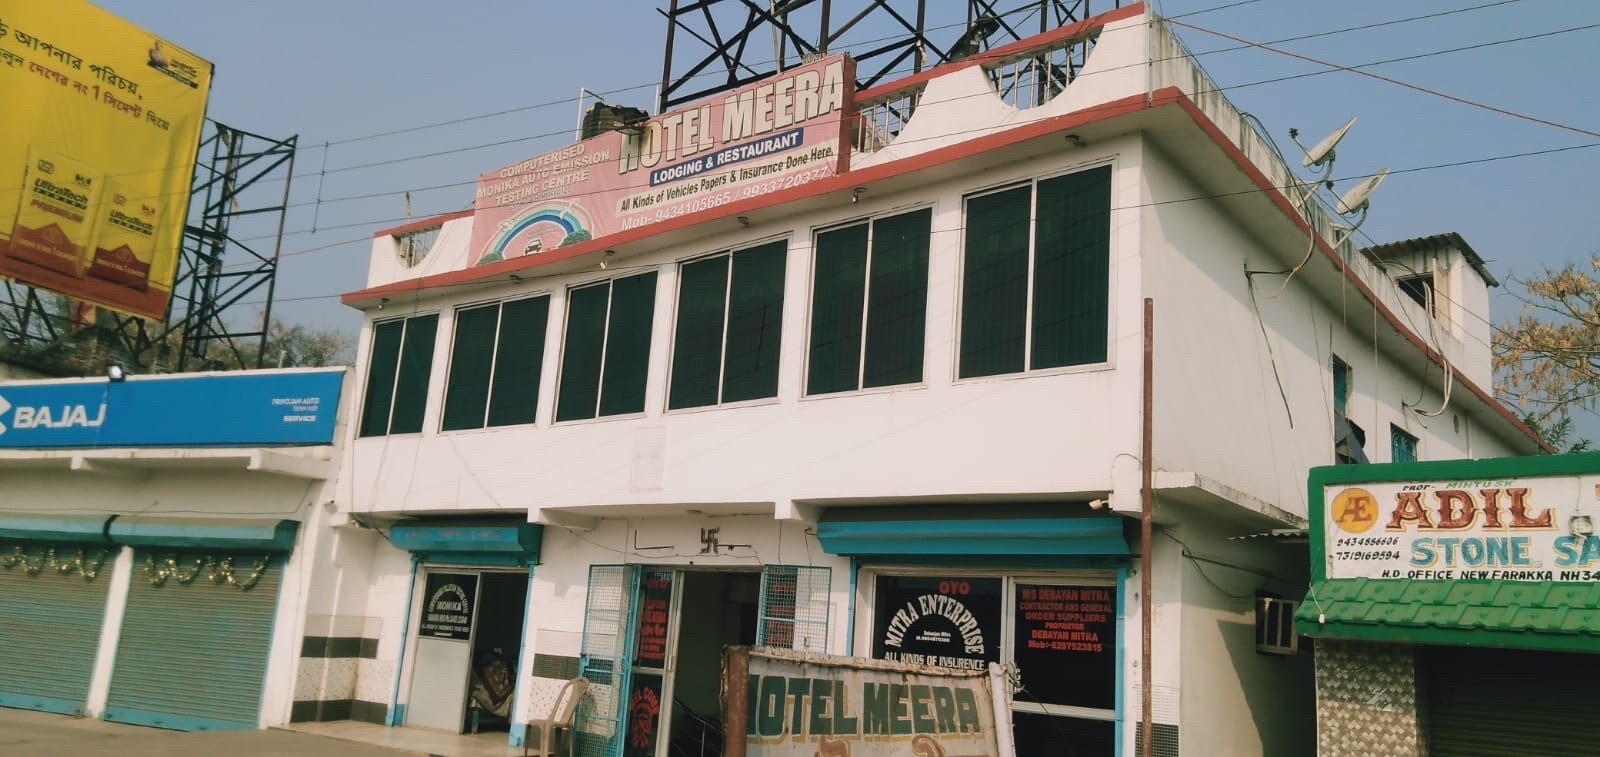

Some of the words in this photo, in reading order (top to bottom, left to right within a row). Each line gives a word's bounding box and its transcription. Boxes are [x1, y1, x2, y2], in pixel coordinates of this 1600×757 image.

[14, 29, 84, 70] আপনার
[29, 61, 70, 86] দেশের
[92, 85, 100, 101] 1
[618, 104, 714, 175] HOTEL
[721, 61, 844, 144] MEERA
[476, 177, 519, 198] MONIKA
[520, 169, 550, 185] AUTO
[553, 149, 610, 175] EMISSION
[500, 144, 585, 178] COMPUTERISED
[653, 160, 703, 184] LODGING
[705, 156, 714, 169] &
[717, 131, 800, 165] RESTAURANT
[34, 177, 88, 204] UltraTech
[495, 186, 539, 206] TESTING
[542, 169, 589, 190] CENTRE
[621, 197, 630, 212] All
[632, 194, 654, 209] Kinds
[656, 189, 664, 203] of
[666, 183, 698, 201] Vehicles
[700, 175, 727, 192] Papers
[729, 170, 737, 183] &
[740, 161, 784, 181] Insurance
[785, 154, 809, 169] Done
[13, 403, 107, 429] BAJAJ
[1385, 487, 1555, 531] ADIL
[938, 580, 970, 596] OYO
[1407, 570, 1453, 580] OFFICE
[1020, 602, 1063, 611] CONTRACTOR
[1039, 589, 1078, 600] DEBAYAN
[1081, 590, 1109, 601] MITRA
[884, 601, 919, 648] MITRA
[918, 594, 984, 654] ENTERPRISE
[1025, 612, 1055, 620] ORDER
[1057, 613, 1106, 622] SUPPLIERS
[1032, 630, 1069, 640] DEBAYAN
[1071, 631, 1098, 642] MITRA
[884, 651, 897, 662] ALL
[900, 652, 925, 665] KINDS
[926, 655, 938, 666] OF
[939, 656, 985, 671] INSURENCE
[863, 682, 981, 736] MEERA
